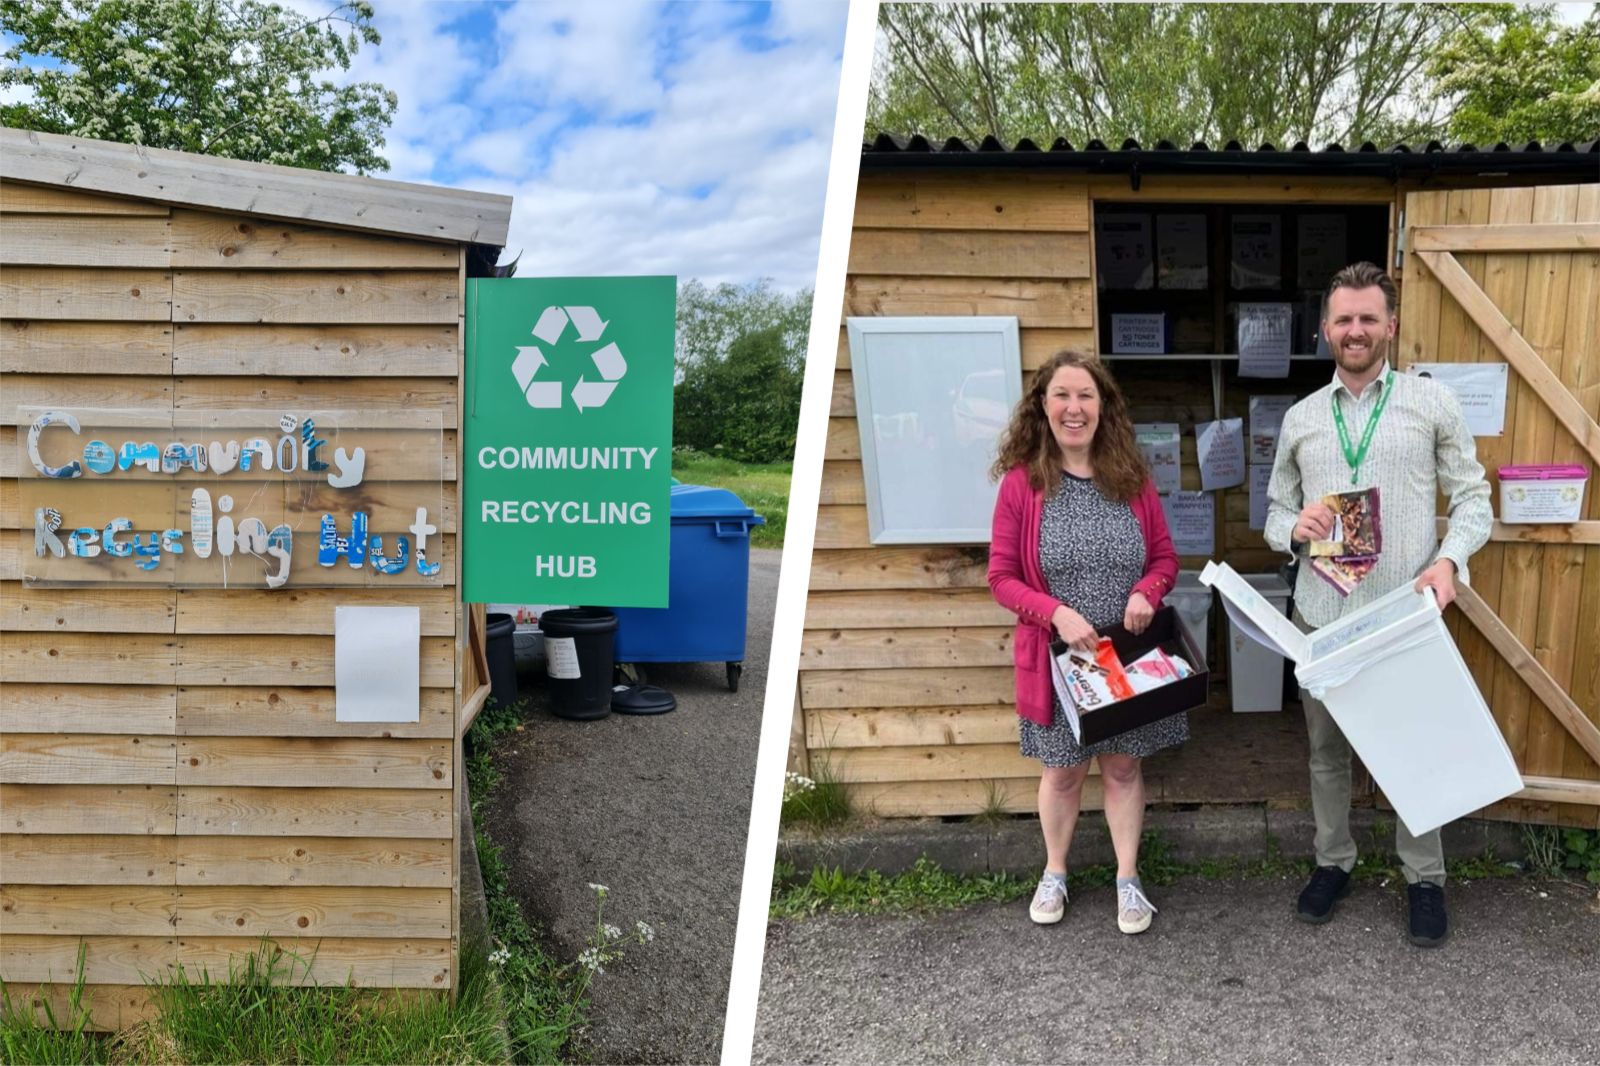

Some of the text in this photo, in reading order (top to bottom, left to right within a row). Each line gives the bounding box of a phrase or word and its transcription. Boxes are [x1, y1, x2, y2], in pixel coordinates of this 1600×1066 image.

[27, 410, 366, 488] Community
[478, 446, 659, 470] COMMUNITY
[481, 501, 652, 525] RECYCLING
[318, 506, 440, 576] Hut
[535, 555, 597, 578] HUB
[1072, 670, 1102, 706] bueno
